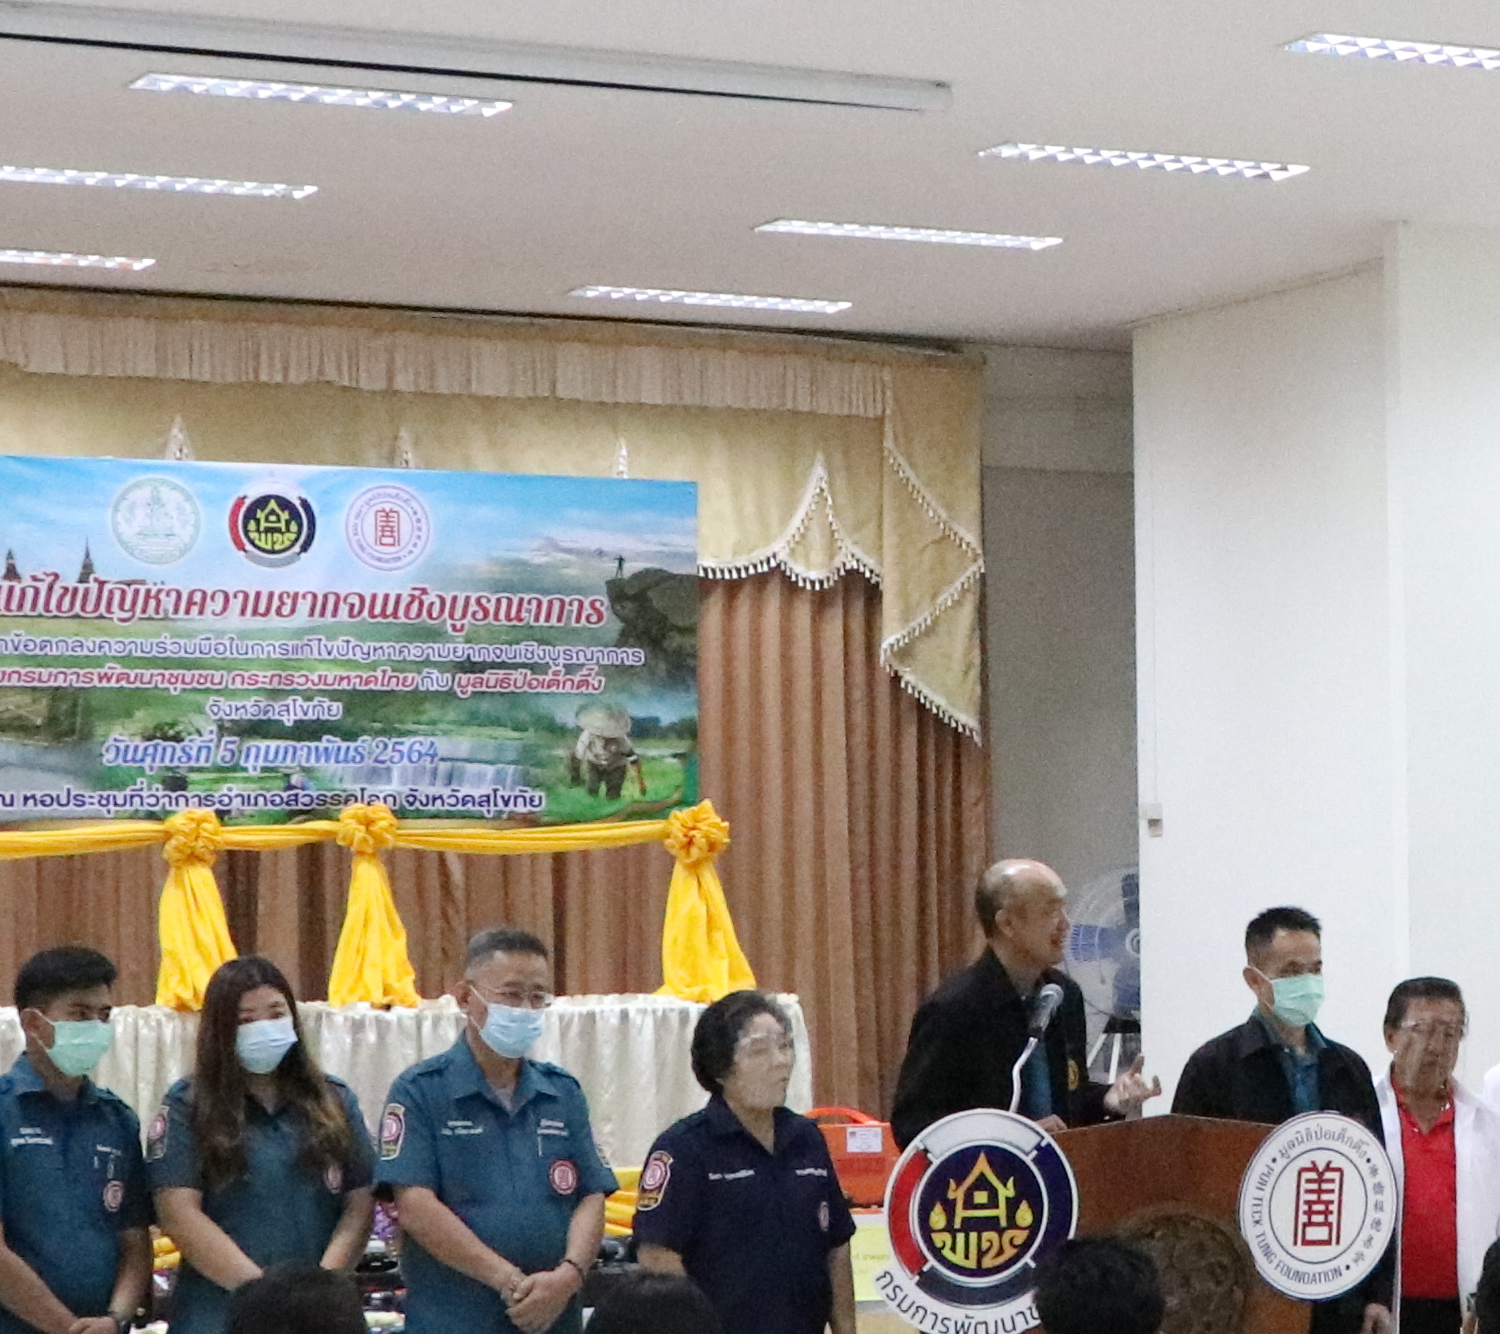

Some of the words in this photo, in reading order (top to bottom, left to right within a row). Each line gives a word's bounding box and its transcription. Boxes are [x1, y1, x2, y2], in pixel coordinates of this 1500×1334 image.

[231, 668, 415, 689] กระทรวงมหาดไทย
[419, 672, 449, 689] กับ
[208, 699, 341, 724] จังหวัดสุโขทัย
[104, 730, 214, 770] วันศุกร์ที่
[221, 738, 238, 764] 5
[244, 736, 366, 772] กุมภาพันธ์
[373, 739, 439, 765] 2564
[404, 787, 543, 814] จังหวัดสุโขทัย
[1250, 1196, 1265, 1228] TECK
[1255, 1230, 1275, 1266] TUNG
[1274, 1258, 1344, 1285] FOUNDATION
